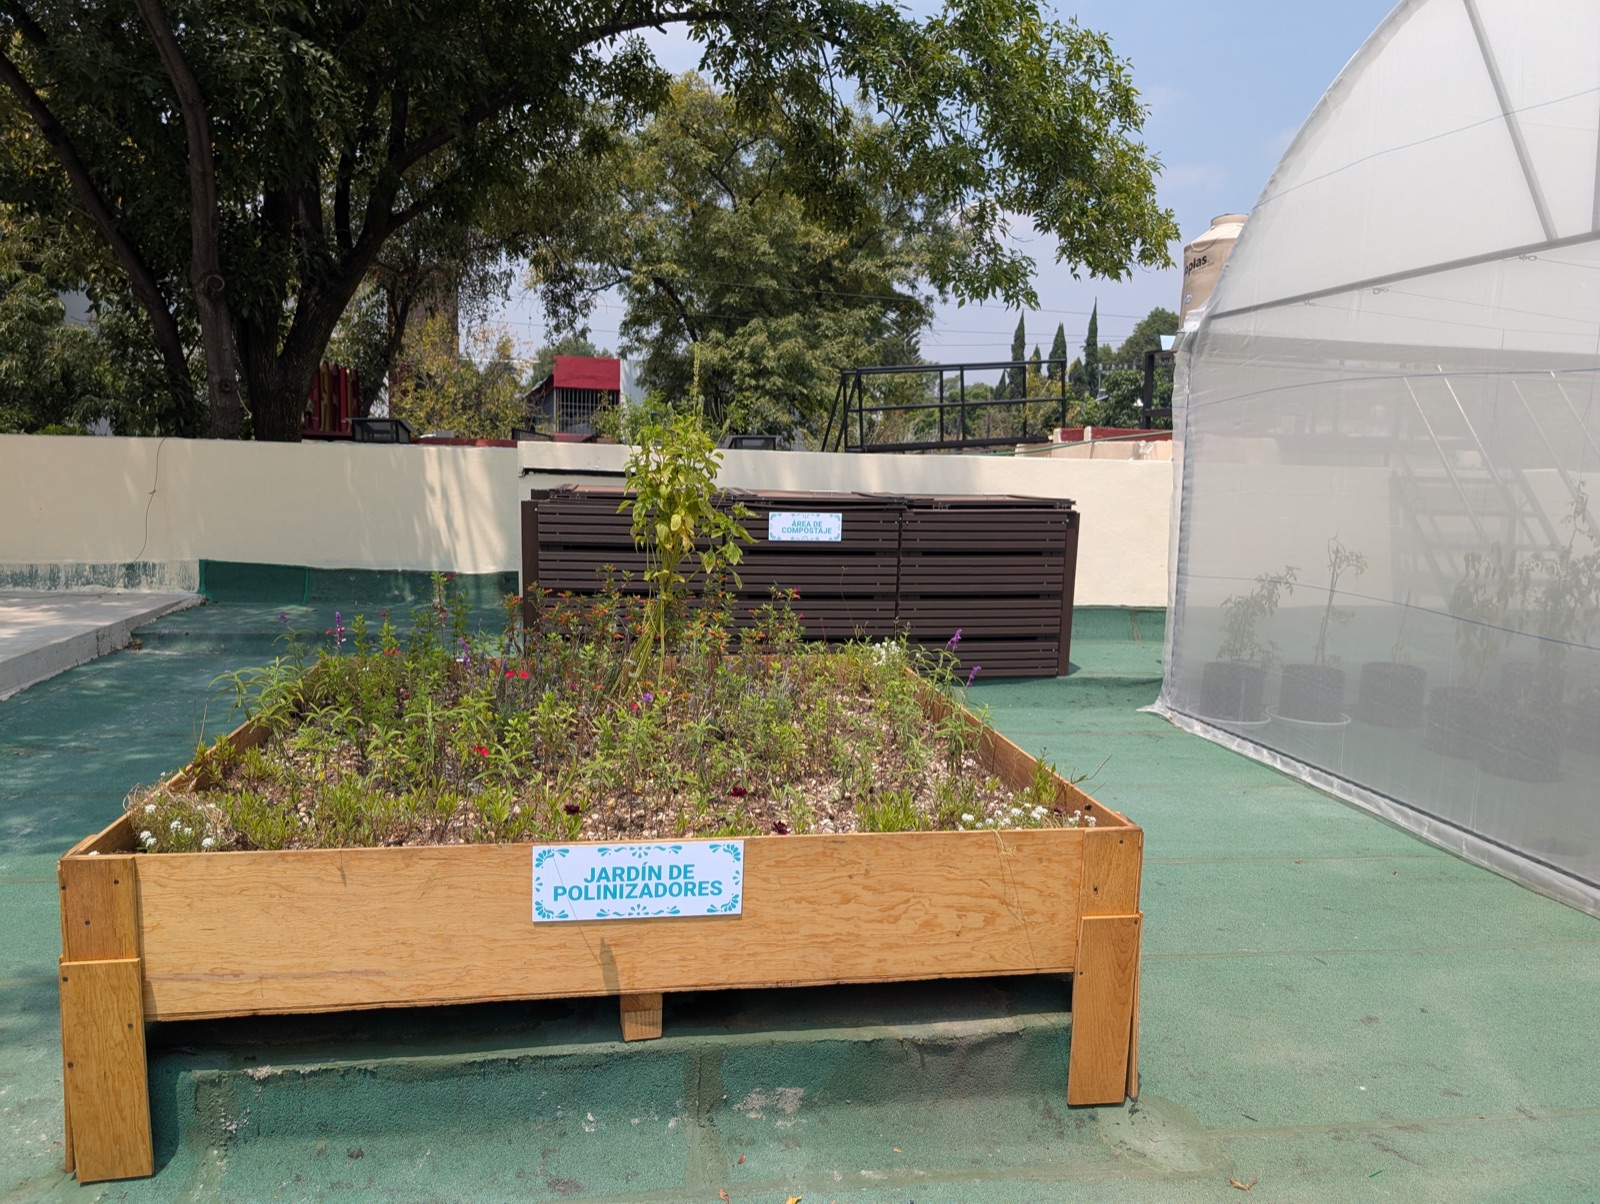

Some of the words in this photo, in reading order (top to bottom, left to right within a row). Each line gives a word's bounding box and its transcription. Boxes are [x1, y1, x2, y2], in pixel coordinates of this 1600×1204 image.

[1184, 255, 1207, 276] oplas
[583, 862, 662, 883] JARDÍN
[668, 864, 695, 880] DE
[553, 880, 723, 901] POLINIZADORES
